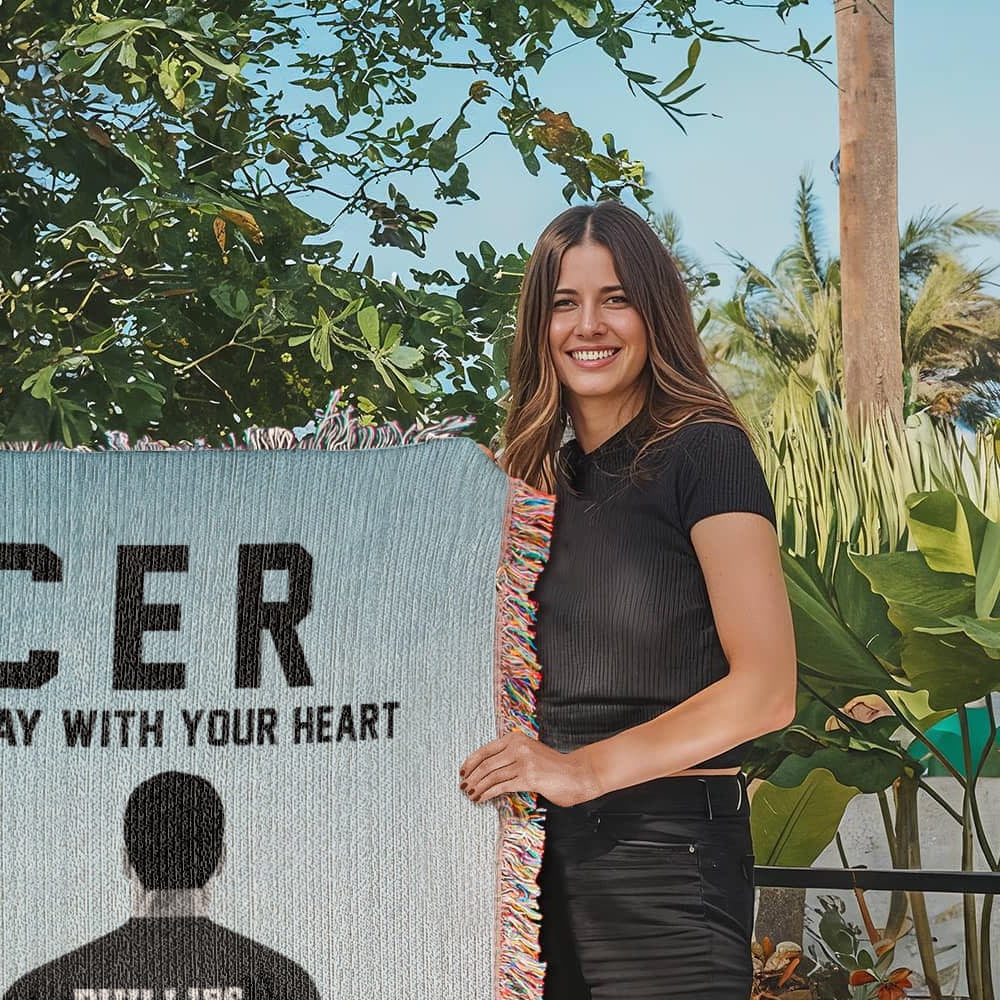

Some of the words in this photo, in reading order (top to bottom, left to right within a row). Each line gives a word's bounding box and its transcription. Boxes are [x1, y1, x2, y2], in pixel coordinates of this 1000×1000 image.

[62, 709, 165, 748] WITH
[181, 707, 278, 747] YOUR
[293, 701, 400, 745] HEART
